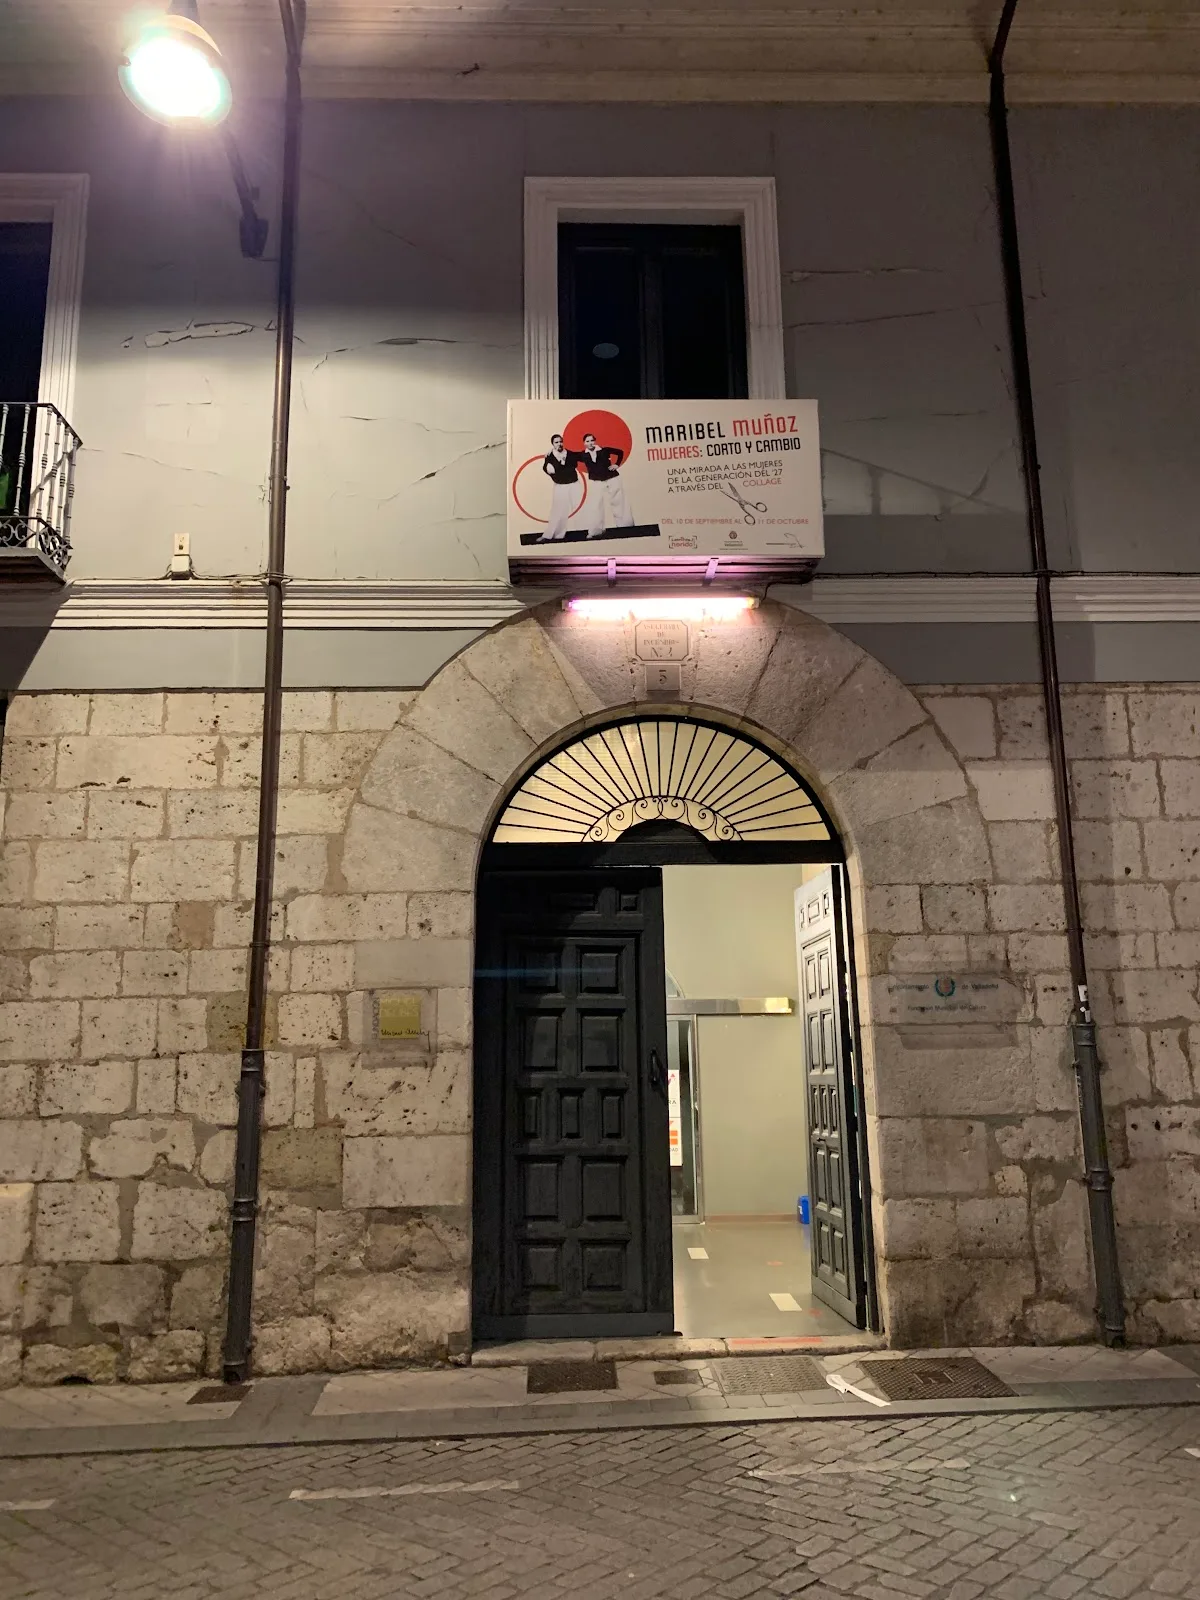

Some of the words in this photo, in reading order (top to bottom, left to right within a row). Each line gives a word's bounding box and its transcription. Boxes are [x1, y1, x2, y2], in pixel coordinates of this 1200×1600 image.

[646, 421, 726, 444] MARIBEL
[732, 414, 798, 437] MUÑOZ
[647, 445, 704, 461] MUJERES:
[706, 442, 742, 457] CORTO
[745, 441, 752, 454] Y
[756, 438, 801, 453] CAMBIO
[689, 465, 722, 474] MIRADA
[732, 462, 746, 470] LAS
[748, 460, 783, 469] MUJERES
[694, 470, 752, 482] GENERACIÓN
[754, 470, 770, 478] DEL
[675, 482, 706, 492] TRAVÉS
[708, 482, 724, 490] DEL
[742, 478, 782, 488] COLLAGE
